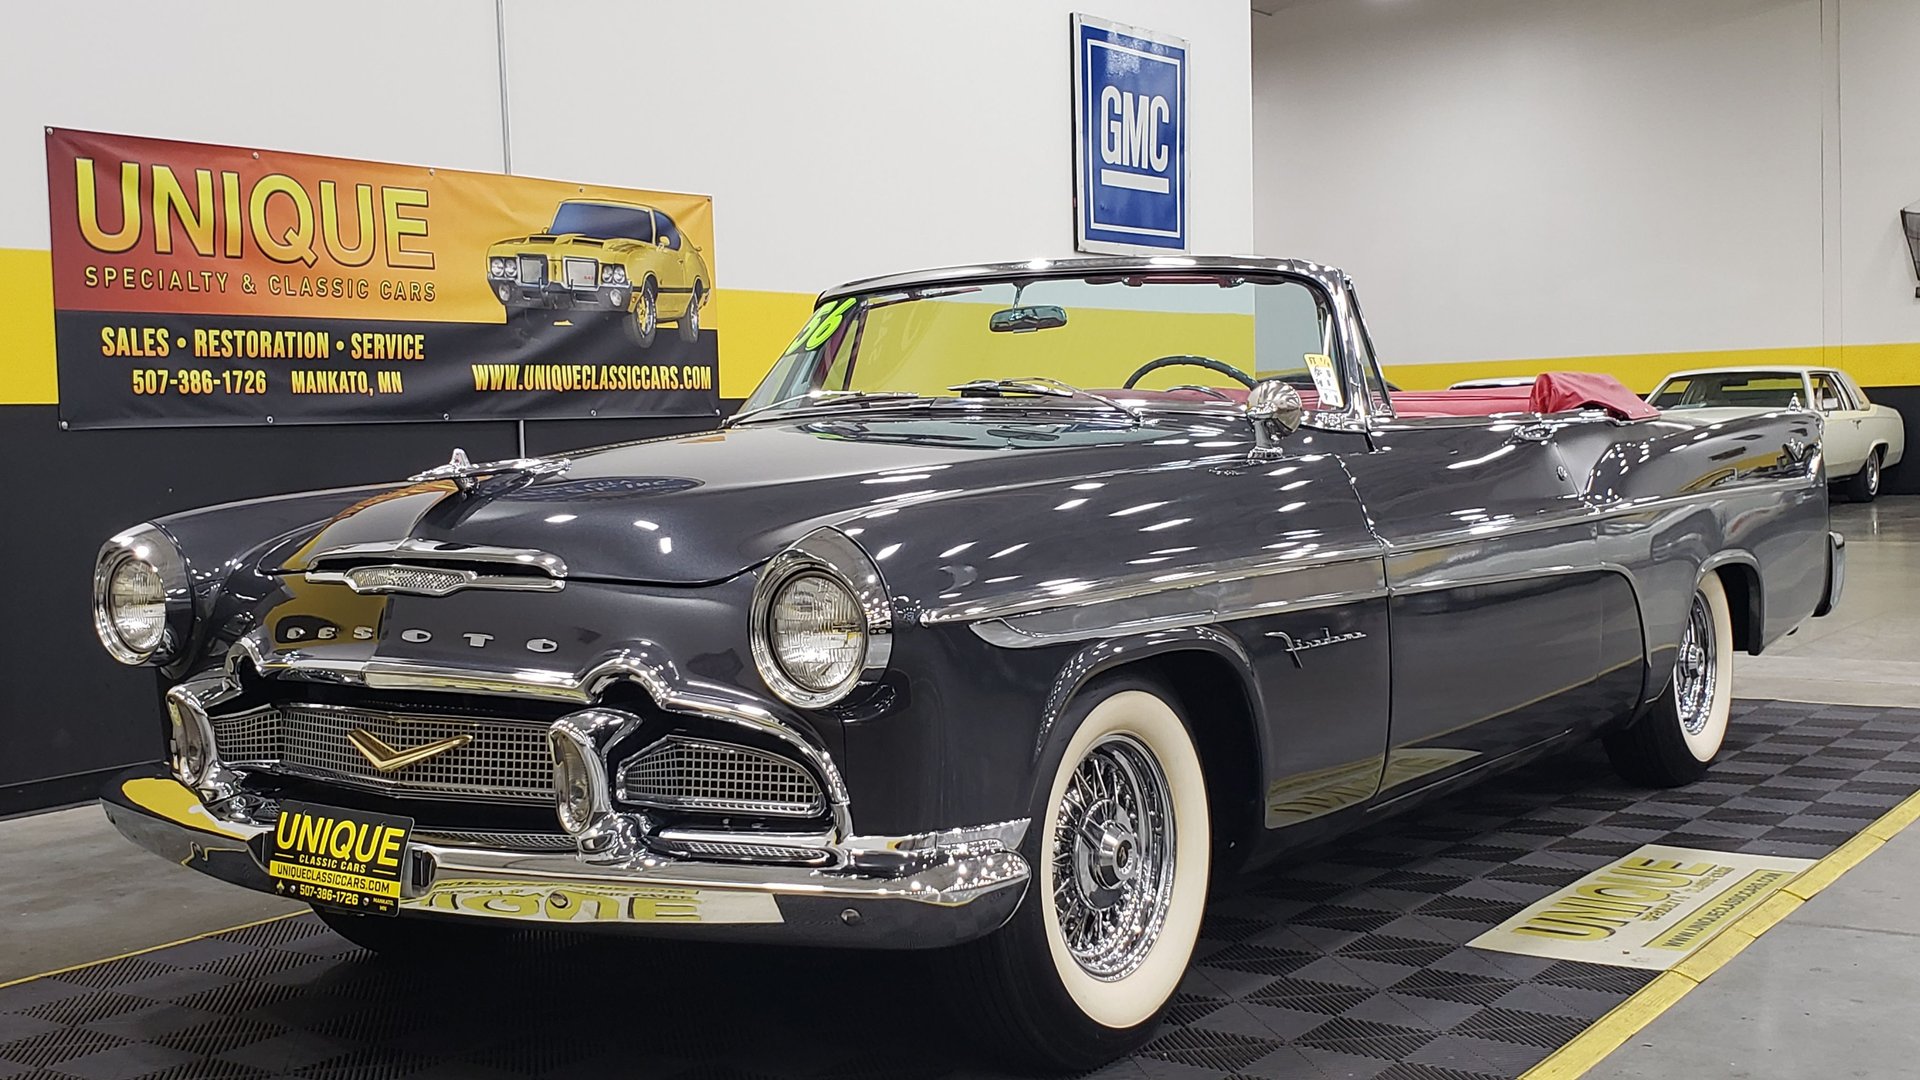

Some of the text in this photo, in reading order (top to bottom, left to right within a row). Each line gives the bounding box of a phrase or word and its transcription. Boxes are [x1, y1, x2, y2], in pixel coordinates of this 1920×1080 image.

[1100, 85, 1170, 173] GMC
[74, 157, 436, 270] UNIQUE
[84, 265, 436, 302] SPECIALTY & CLASSIC CARS
[101, 327, 425, 360] SALES RESTORATION SERVICE
[132, 369, 403, 397] 507-386-1726 MANKATO, MN
[471, 364, 712, 392] WWW.UNIQUECLASSICCARS.COM
[276, 811, 406, 867] UNIQUE
[277, 864, 390, 894] UNIQUECLASSICCARS.COM
[299, 854, 367, 874] CLASSIC CARS
[300, 884, 359, 906] 507-386-1726
[1511, 856, 1718, 942] UNIQUE
